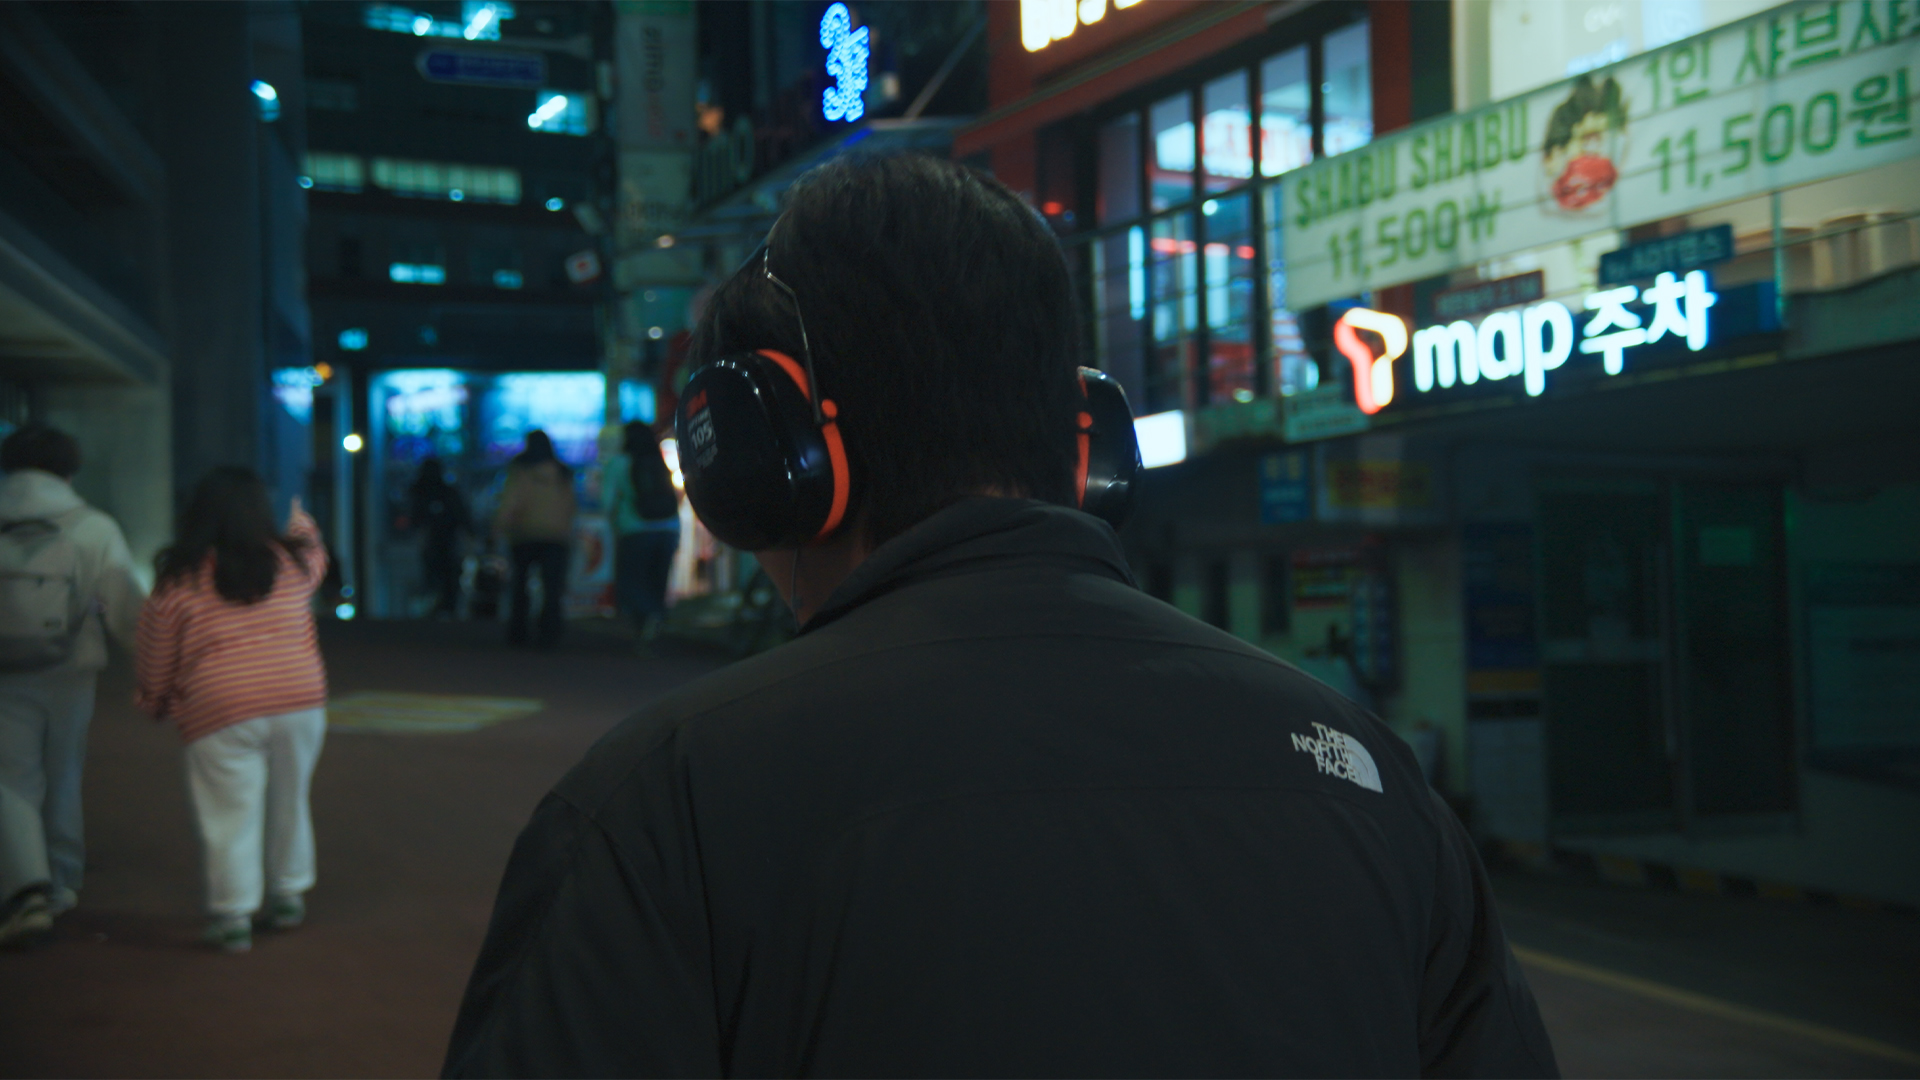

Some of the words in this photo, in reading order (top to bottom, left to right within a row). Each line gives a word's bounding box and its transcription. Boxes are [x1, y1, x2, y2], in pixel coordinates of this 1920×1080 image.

[1643, 37, 1710, 111] 1인
[1734, 0, 1920, 84] 샤브샤
[1296, 145, 1397, 229] SHABU
[1410, 102, 1529, 190] SHABU
[1652, 66, 1911, 193] 11,500원
[1413, 301, 1574, 397] map
[1578, 269, 1718, 375] 주차
[1291, 732, 1349, 764] NORTH
[1311, 721, 1346, 747] THE
[1315, 753, 1356, 780] FACE
